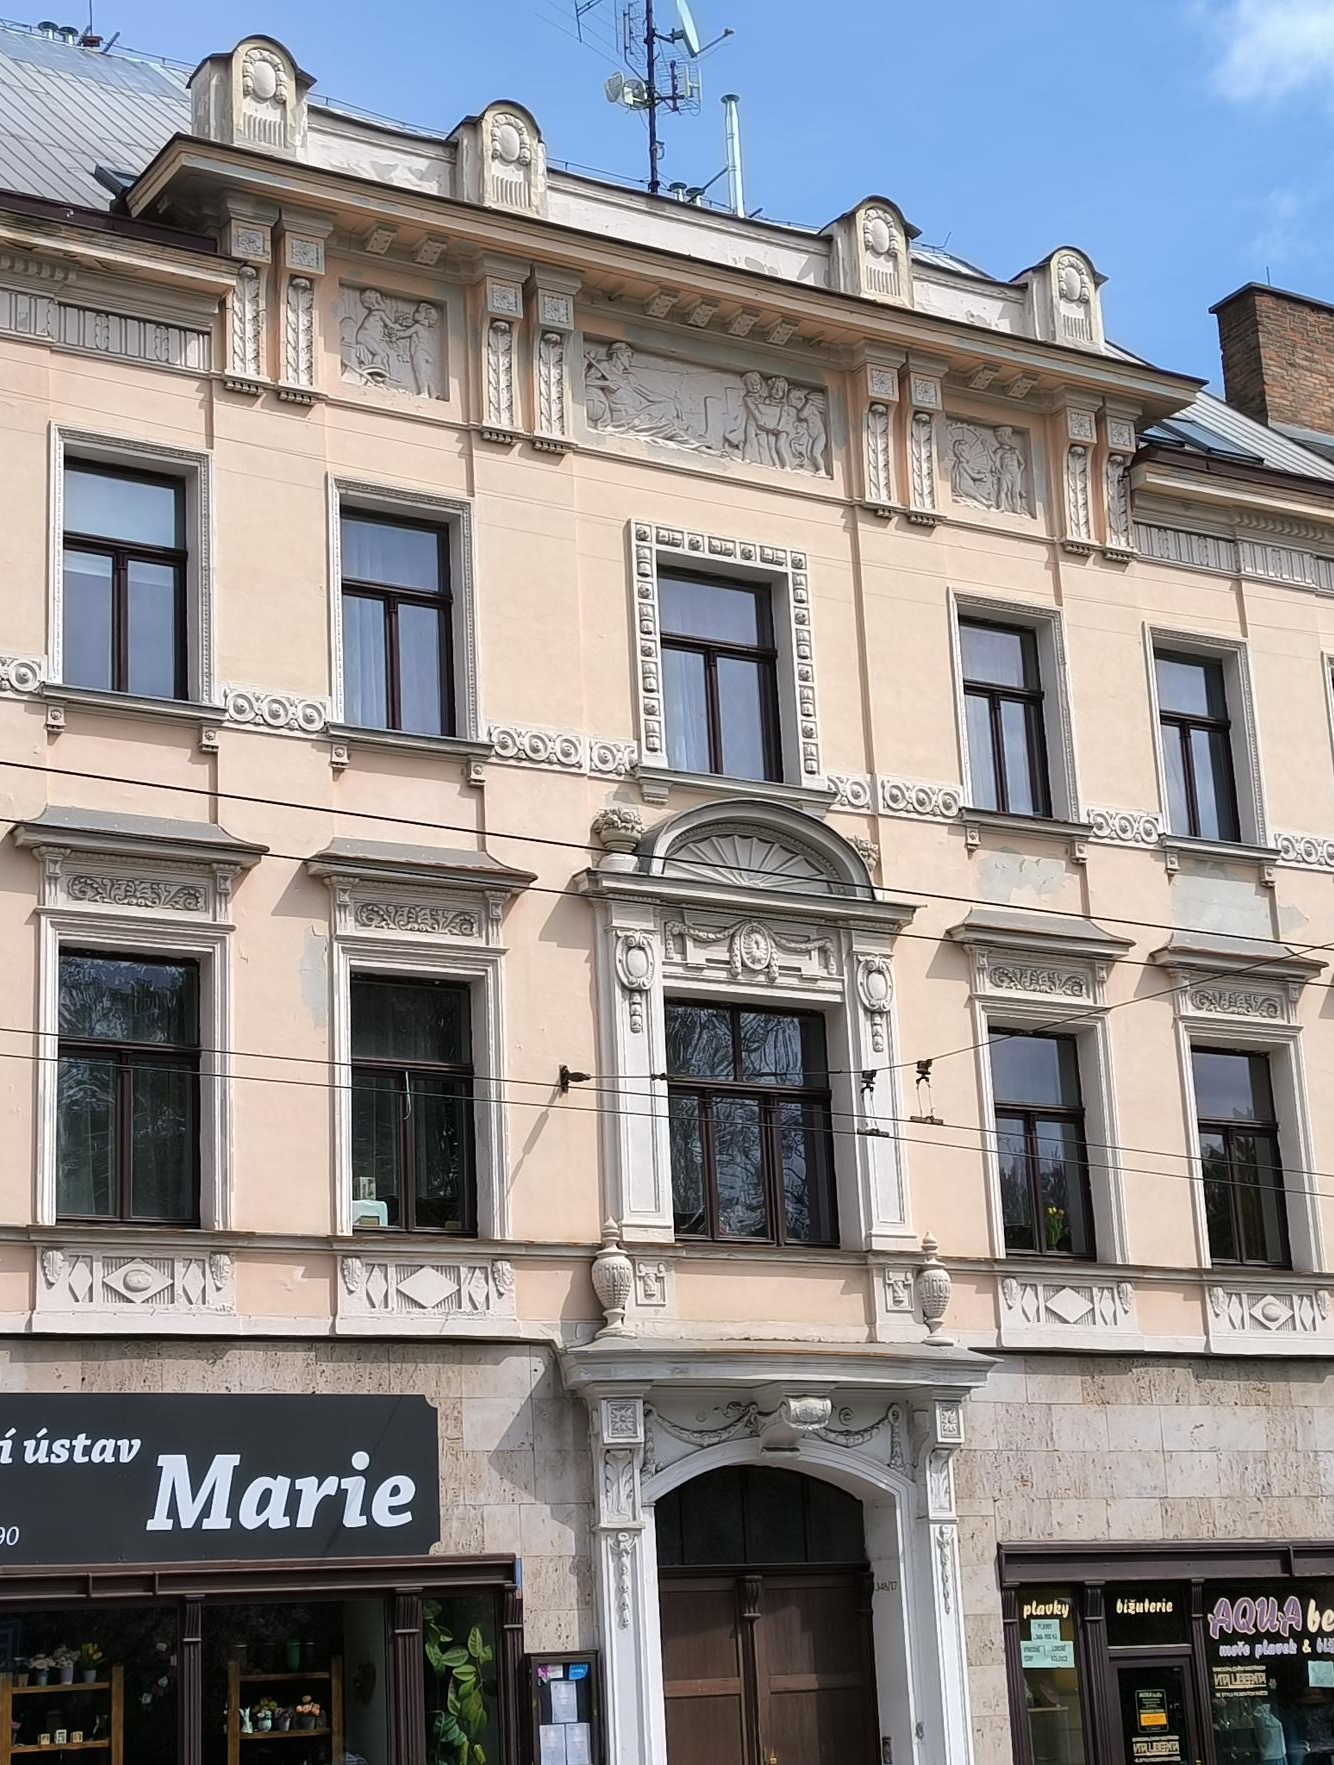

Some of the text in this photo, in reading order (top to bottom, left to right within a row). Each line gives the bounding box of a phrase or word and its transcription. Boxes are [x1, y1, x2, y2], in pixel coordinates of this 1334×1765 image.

[23, 1427, 141, 1464] ústav
[145, 1450, 416, 1531] Marie
[1023, 1599, 1070, 1619] plavky
[1116, 1597, 1174, 1615] bižuterie
[1207, 1595, 1303, 1640] AQUA
[1219, 1640, 1251, 1658] moře
[1254, 1637, 1298, 1659] plavek
[1301, 1638, 1312, 1654] &
